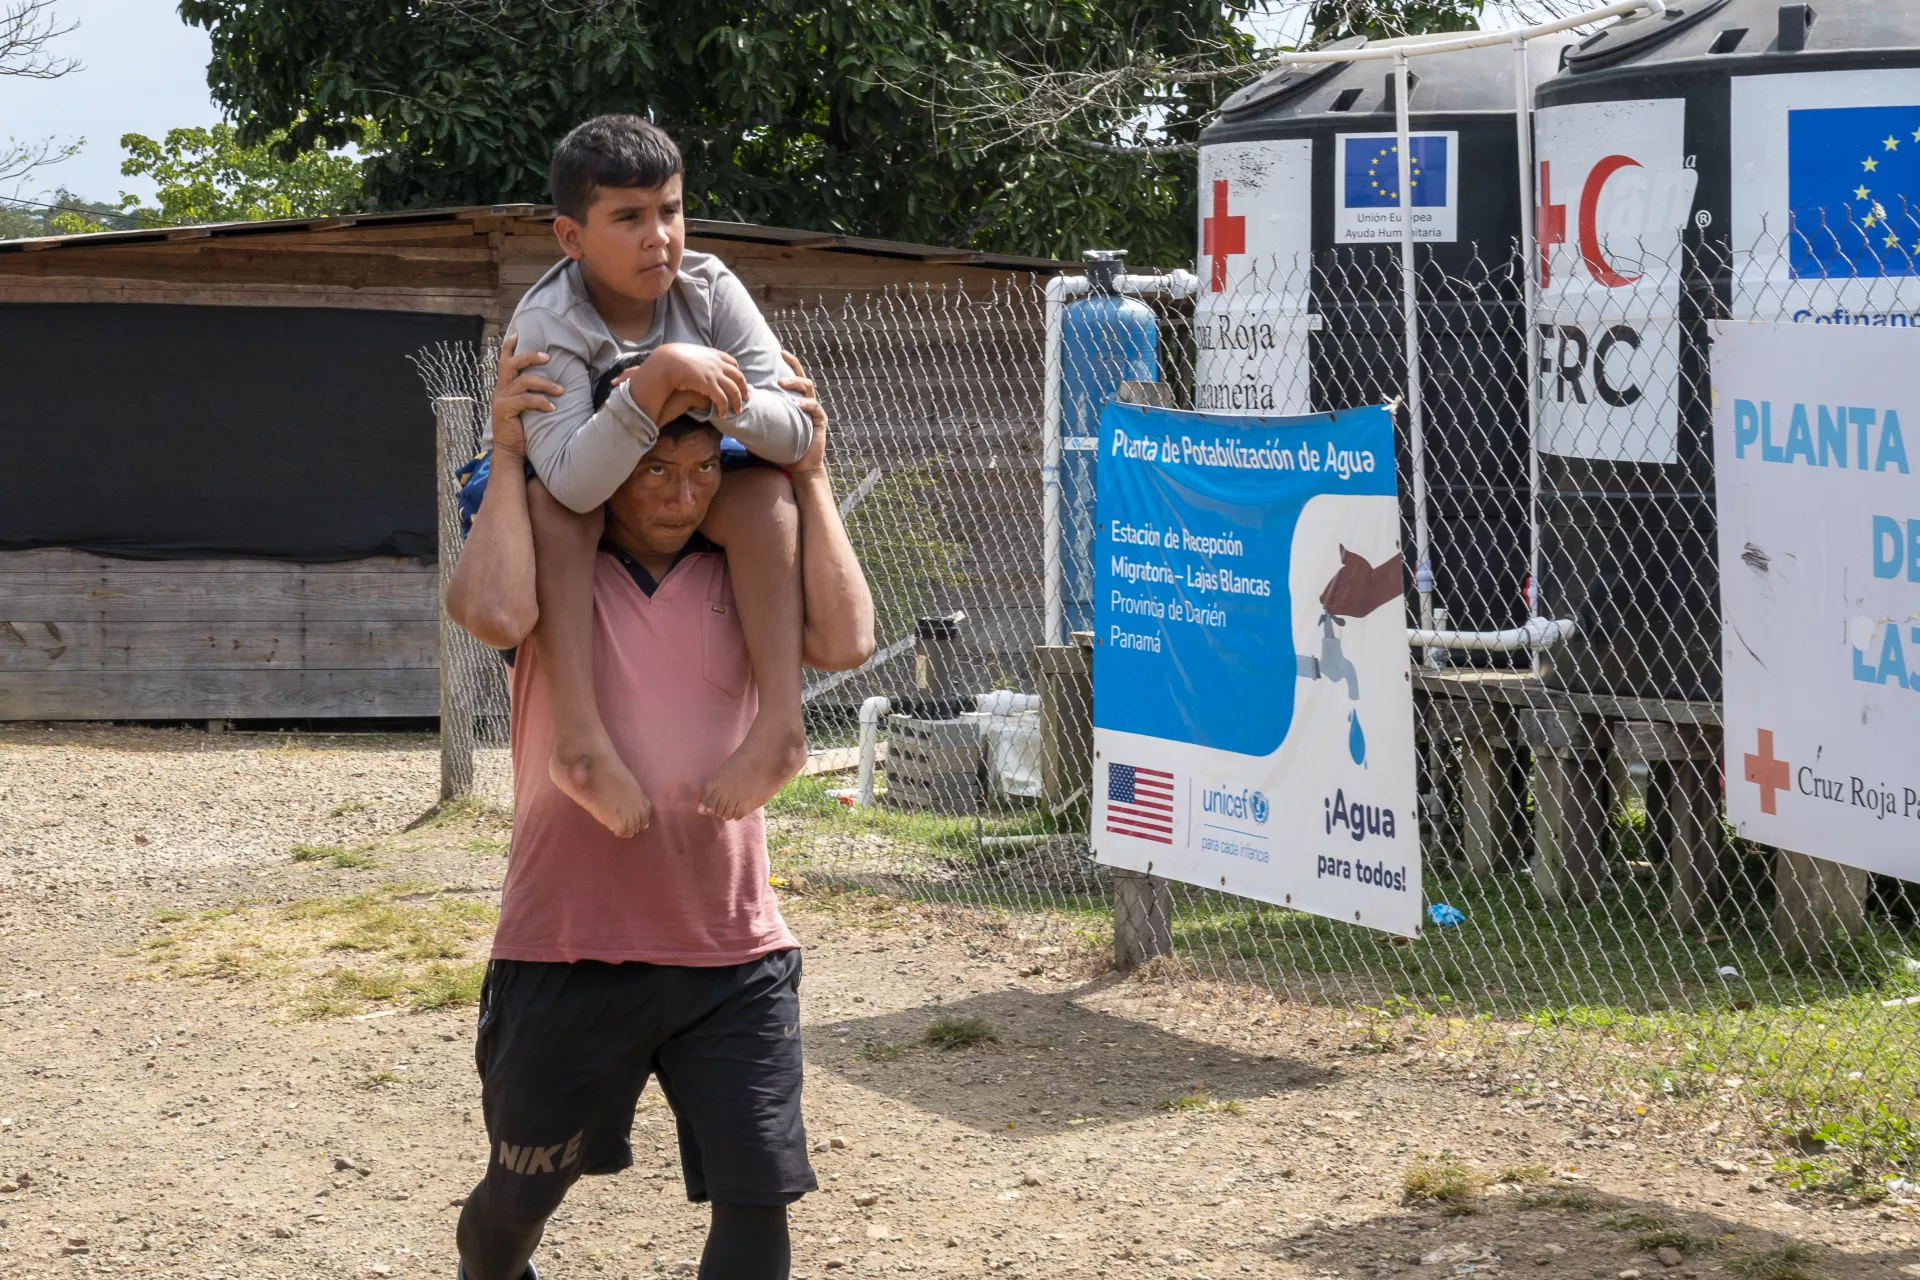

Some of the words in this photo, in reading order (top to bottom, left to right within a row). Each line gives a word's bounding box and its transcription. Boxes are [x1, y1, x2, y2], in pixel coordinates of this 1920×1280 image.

[1345, 229, 1375, 240] Ayuda
[1357, 213, 1387, 222] Unión
[1389, 212, 1432, 224] Eupea
[1218, 313, 1276, 360] Roja
[1111, 428, 1158, 461] Planta
[1161, 434, 1181, 464] de
[1181, 435, 1294, 471] Potabilización
[1298, 441, 1320, 472] de
[1324, 441, 1375, 481] Agua
[1734, 398, 1910, 474] PLANTA
[1111, 520, 1160, 547] Estación
[1164, 527, 1180, 550] de
[1182, 528, 1243, 559] Recepción
[1187, 565, 1218, 594] Lajas
[1219, 569, 1270, 597] Blancas
[1168, 599, 1183, 621] de
[1185, 600, 1226, 628] Darién
[1110, 625, 1161, 653] Panamá
[1203, 784, 1248, 820] unicef
[1798, 766, 1844, 803] Cruz
[1850, 776, 1897, 820] Roja
[1324, 788, 1395, 842] ¡Agua
[1202, 837, 1219, 852] para
[1221, 840, 1238, 856] cada
[1317, 854, 1351, 880] para
[1355, 858, 1406, 893] todos!
[499, 1128, 583, 1175] NIKE
